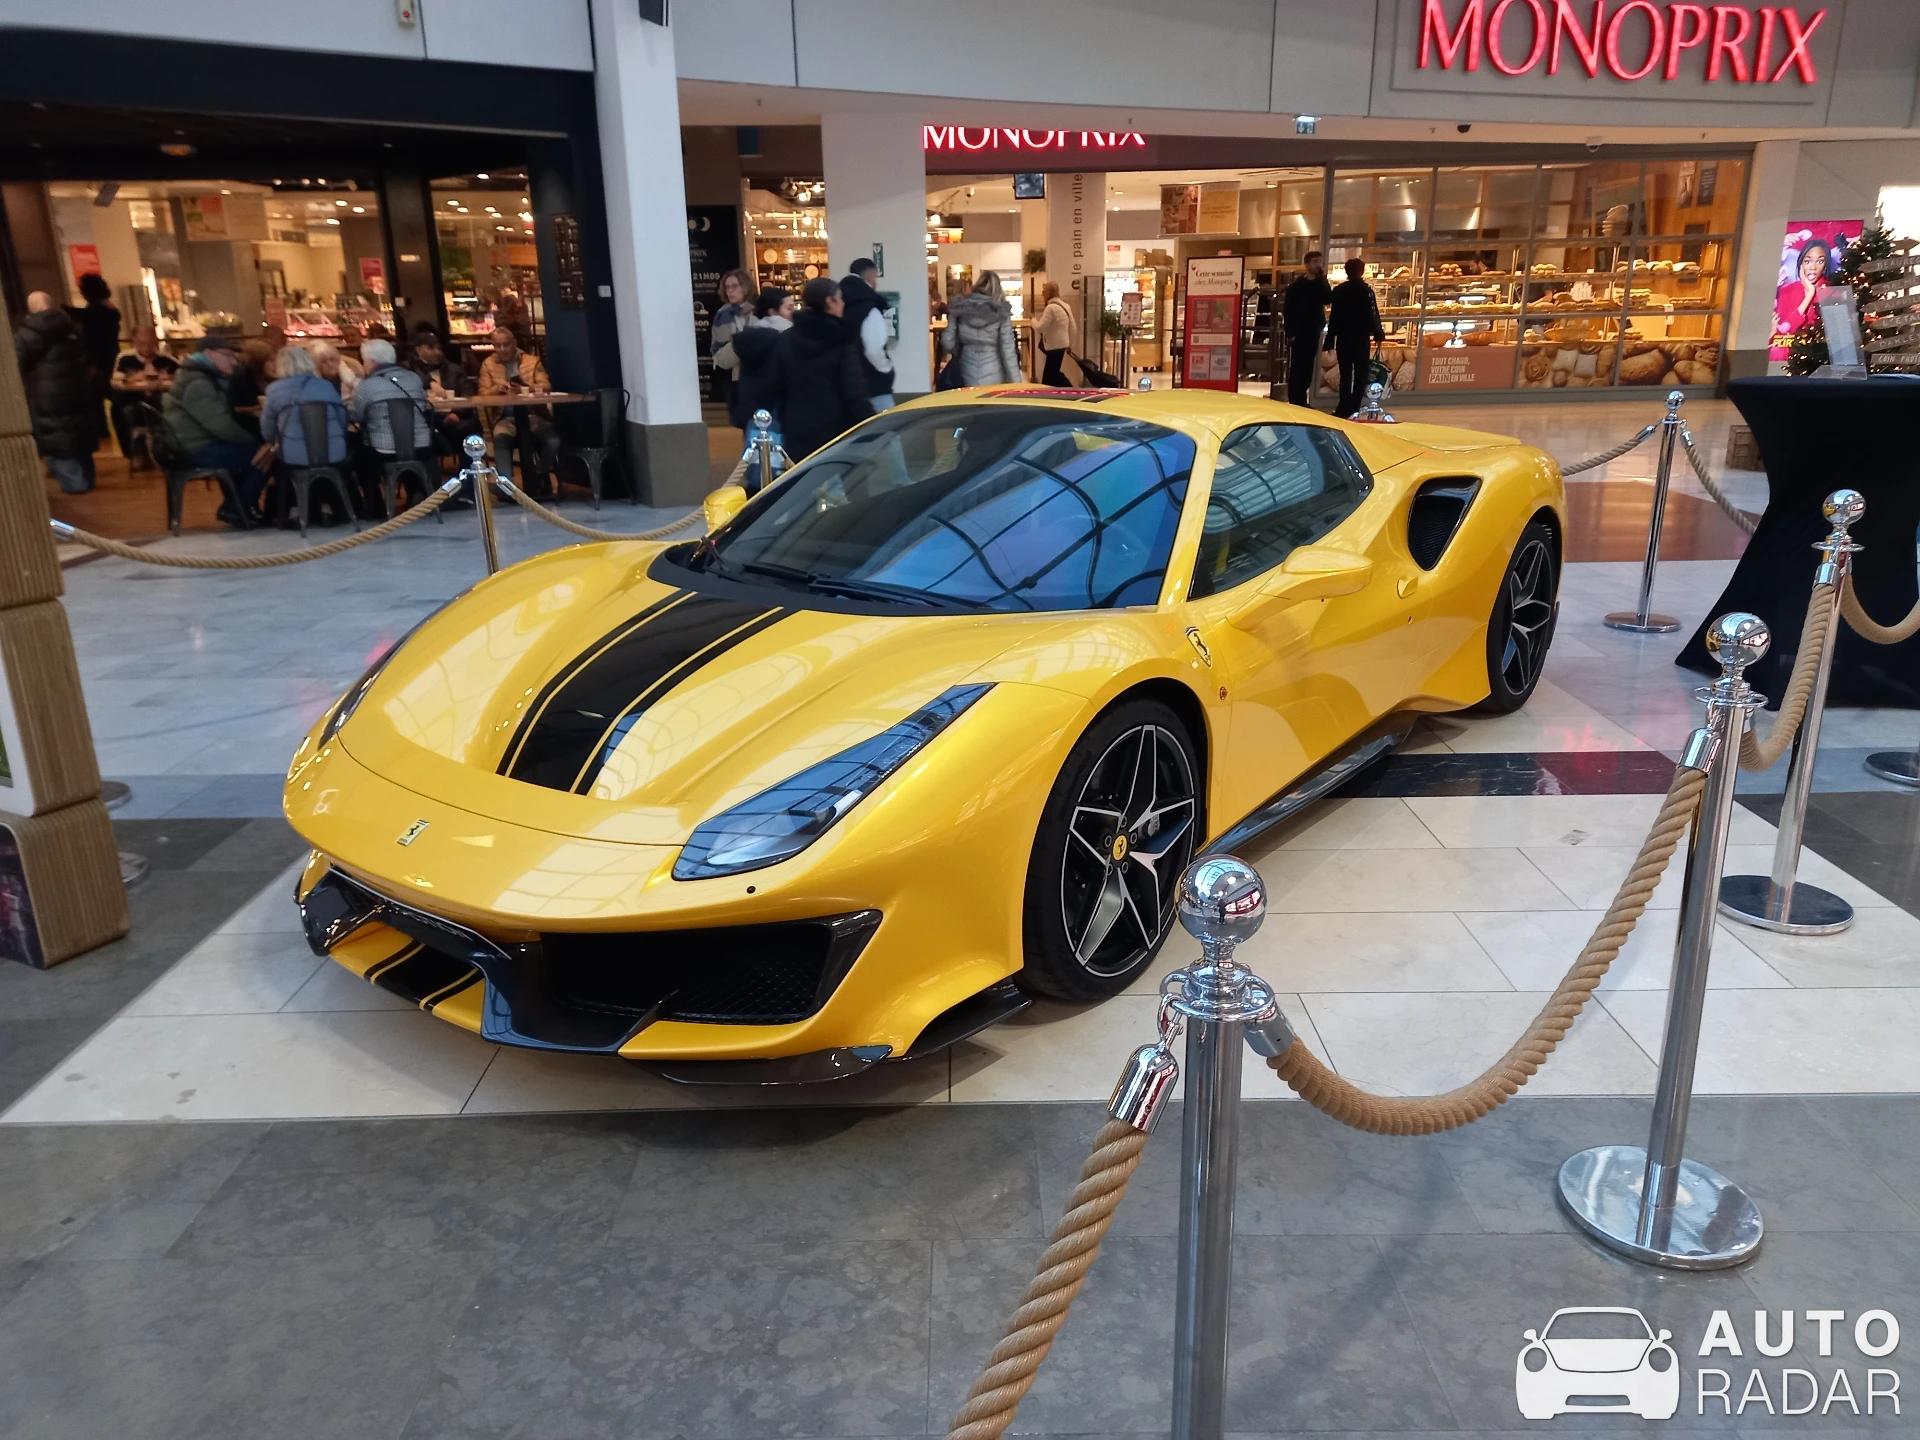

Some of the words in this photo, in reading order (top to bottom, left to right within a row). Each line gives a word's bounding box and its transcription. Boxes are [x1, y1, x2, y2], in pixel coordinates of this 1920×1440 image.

[1418, 0, 1828, 83] MONOPRIX
[1071, 174, 1083, 203] ville
[1073, 208, 1082, 224] en
[1071, 229, 1084, 258] pain
[1432, 357, 1447, 365] TOUT
[1431, 366, 1450, 374] VOTRE
[1429, 374, 1450, 383] PAIN
[1451, 374, 1459, 382] EN
[1459, 374, 1475, 382] VILLE
